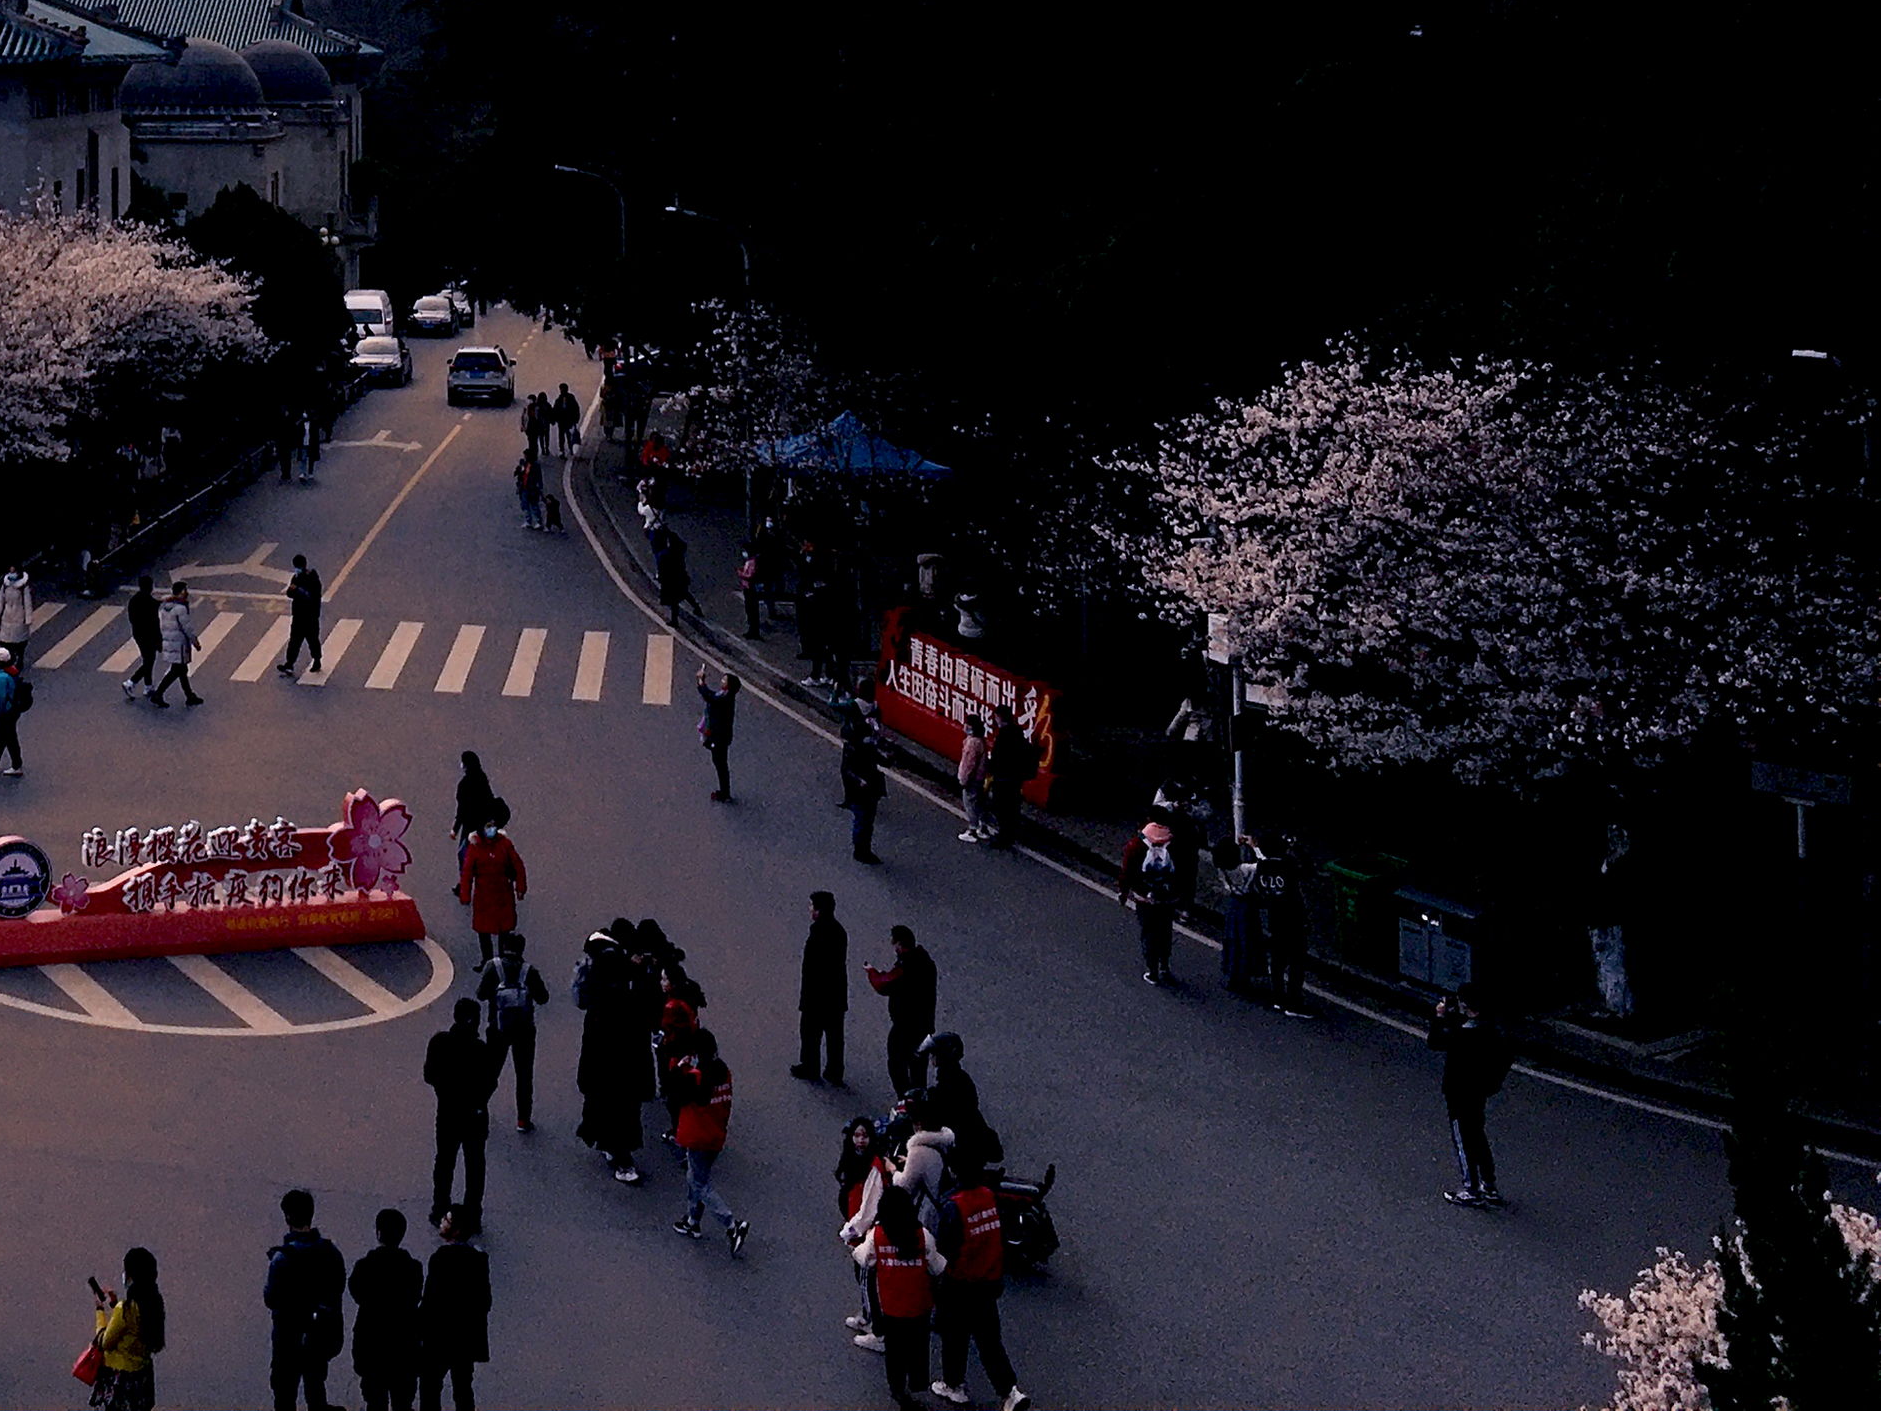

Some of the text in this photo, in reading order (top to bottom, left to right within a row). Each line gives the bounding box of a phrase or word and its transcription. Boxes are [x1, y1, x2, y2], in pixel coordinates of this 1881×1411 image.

[83, 817, 302, 868] 浪漫樱花迎贵客
[124, 861, 344, 913] 携手抗疫约你来
